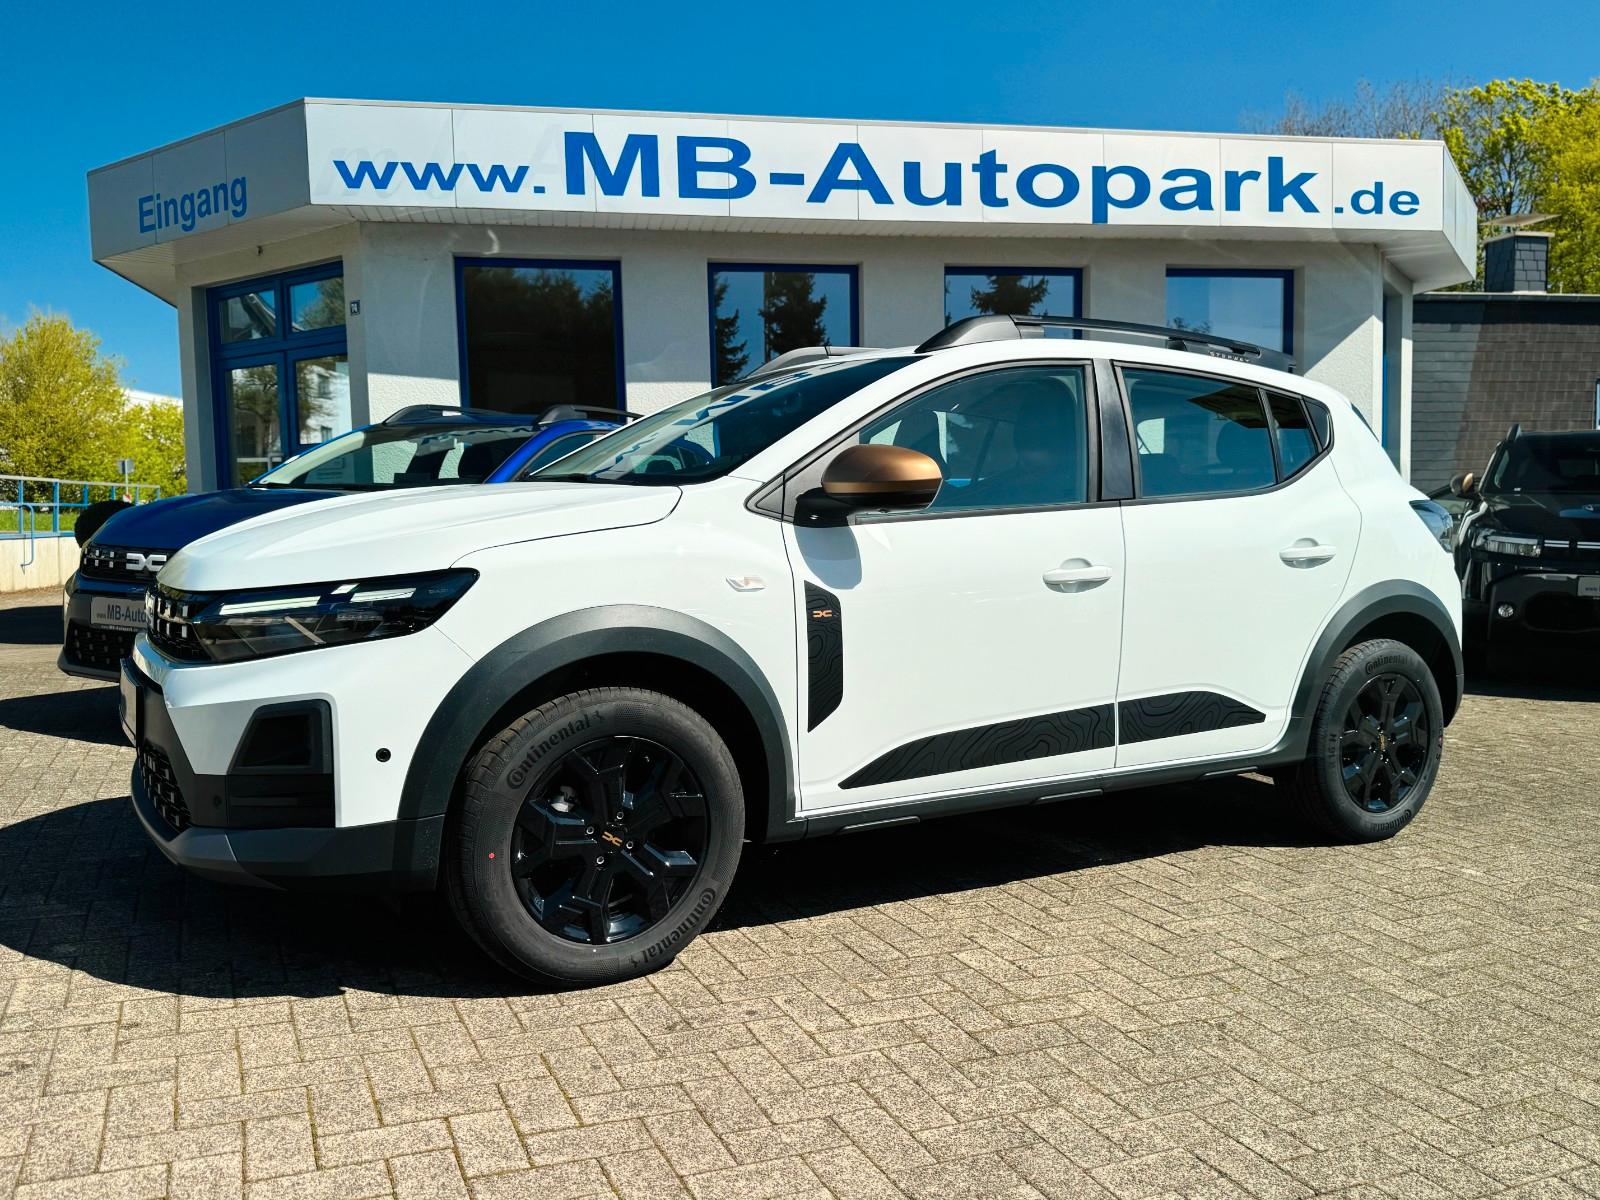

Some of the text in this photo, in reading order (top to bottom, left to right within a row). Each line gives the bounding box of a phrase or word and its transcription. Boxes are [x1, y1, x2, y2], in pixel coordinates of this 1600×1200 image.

[138, 177, 247, 233] Eingang
[506, 713, 592, 789] Continental
[639, 887, 716, 964] Continental
